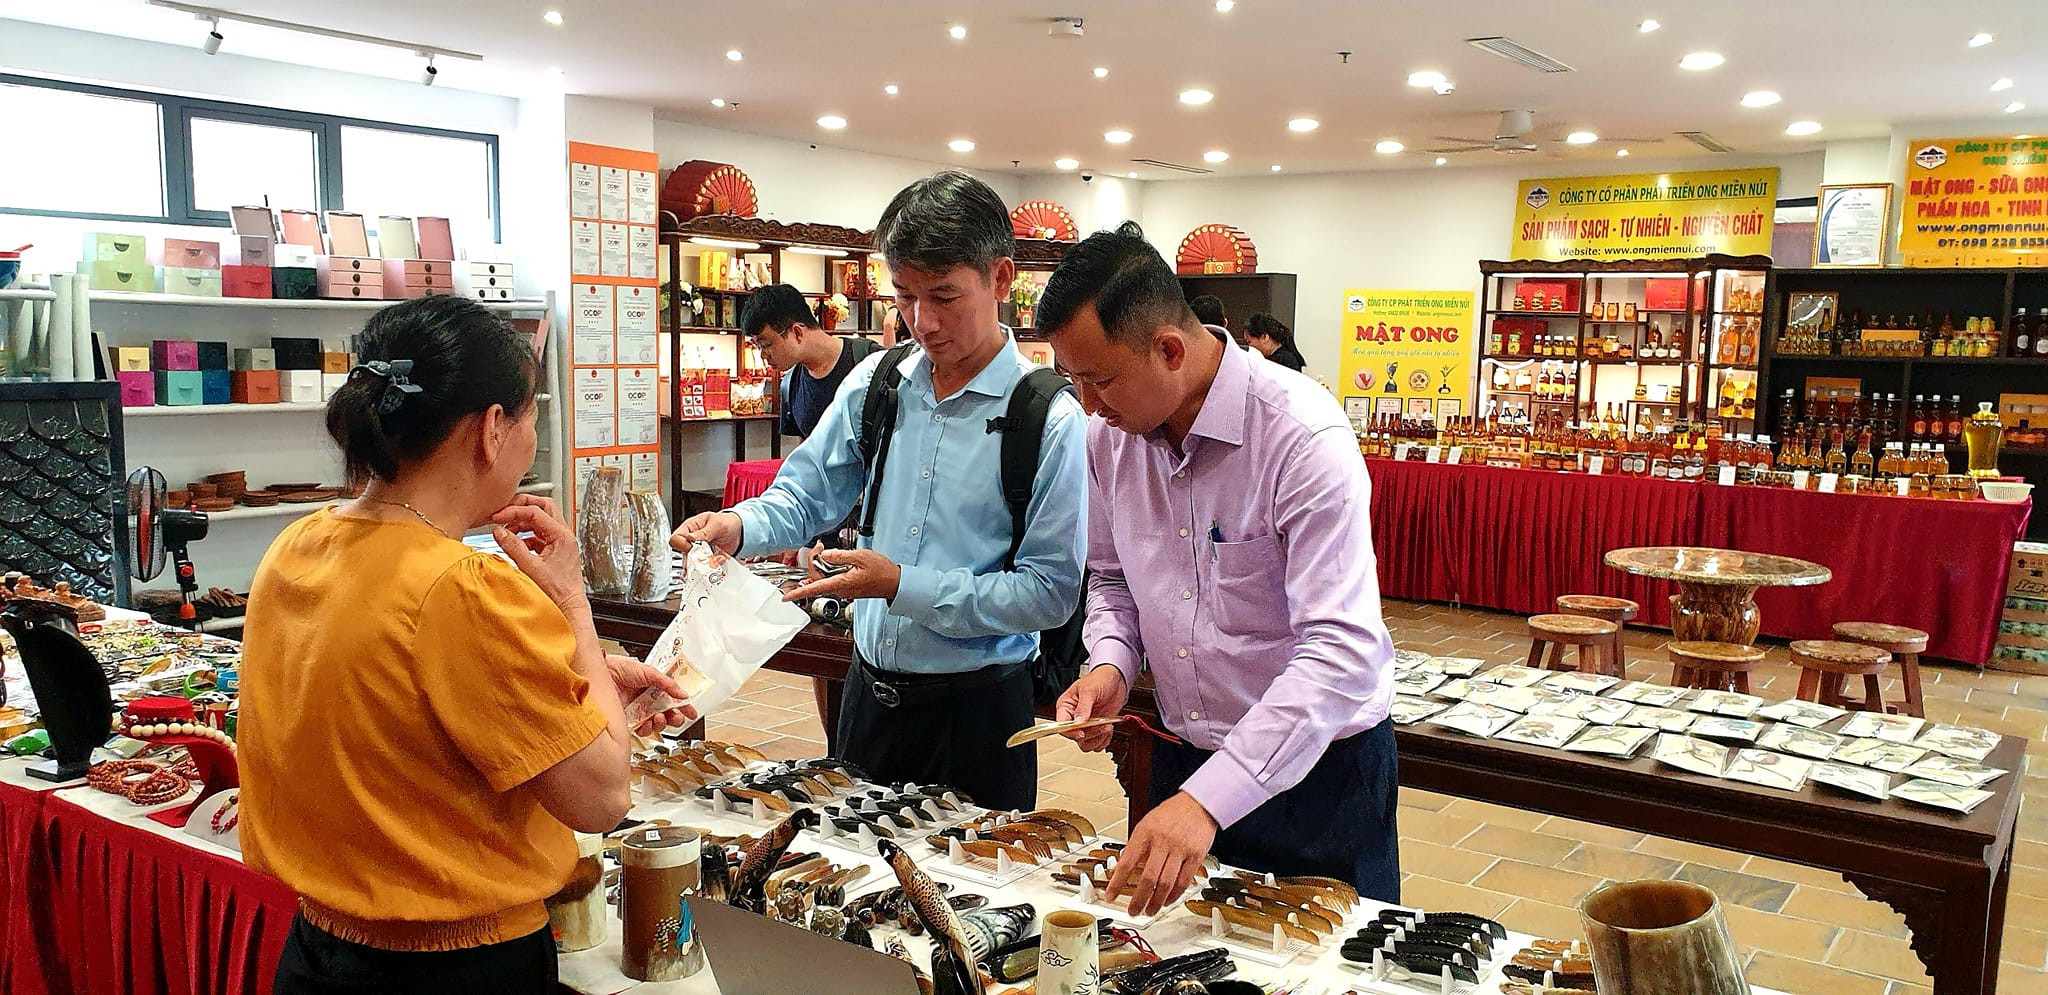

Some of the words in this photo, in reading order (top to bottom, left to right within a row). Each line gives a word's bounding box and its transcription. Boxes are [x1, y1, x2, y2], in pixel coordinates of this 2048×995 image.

[1560, 187, 1584, 204] CÔNG
[1586, 190, 1597, 202] TY
[1614, 184, 1638, 200] PHẦN
[1640, 184, 1663, 200] PHÁT
[1667, 180, 1695, 199] TRIỂN
[1697, 184, 1718, 198] ONG
[1720, 179, 1746, 197] MIỀN
[1748, 178, 1768, 196] NÚI
[1944, 179, 1975, 195] ONG
[1988, 174, 2019, 194] SỮA
[1961, 201, 1990, 217] HOA
[2008, 200, 2042, 217] TINH
[1522, 212, 1544, 241] SẢN
[1546, 212, 1578, 240] PHẨM
[1580, 219, 1610, 243] SẠCH
[1620, 216, 1636, 242] TỰ
[1636, 213, 1672, 238] NHIÊN
[1732, 206, 1764, 236] CHẤT
[1559, 246, 1601, 256] Website:
[1604, 244, 1716, 257] www.ongmiennui.com
[1389, 299, 1397, 307] CP
[1431, 299, 1444, 308] ONG
[626, 310, 646, 318] OCOP
[1356, 322, 1406, 345] MẬT
[1410, 326, 1459, 343] ONG
